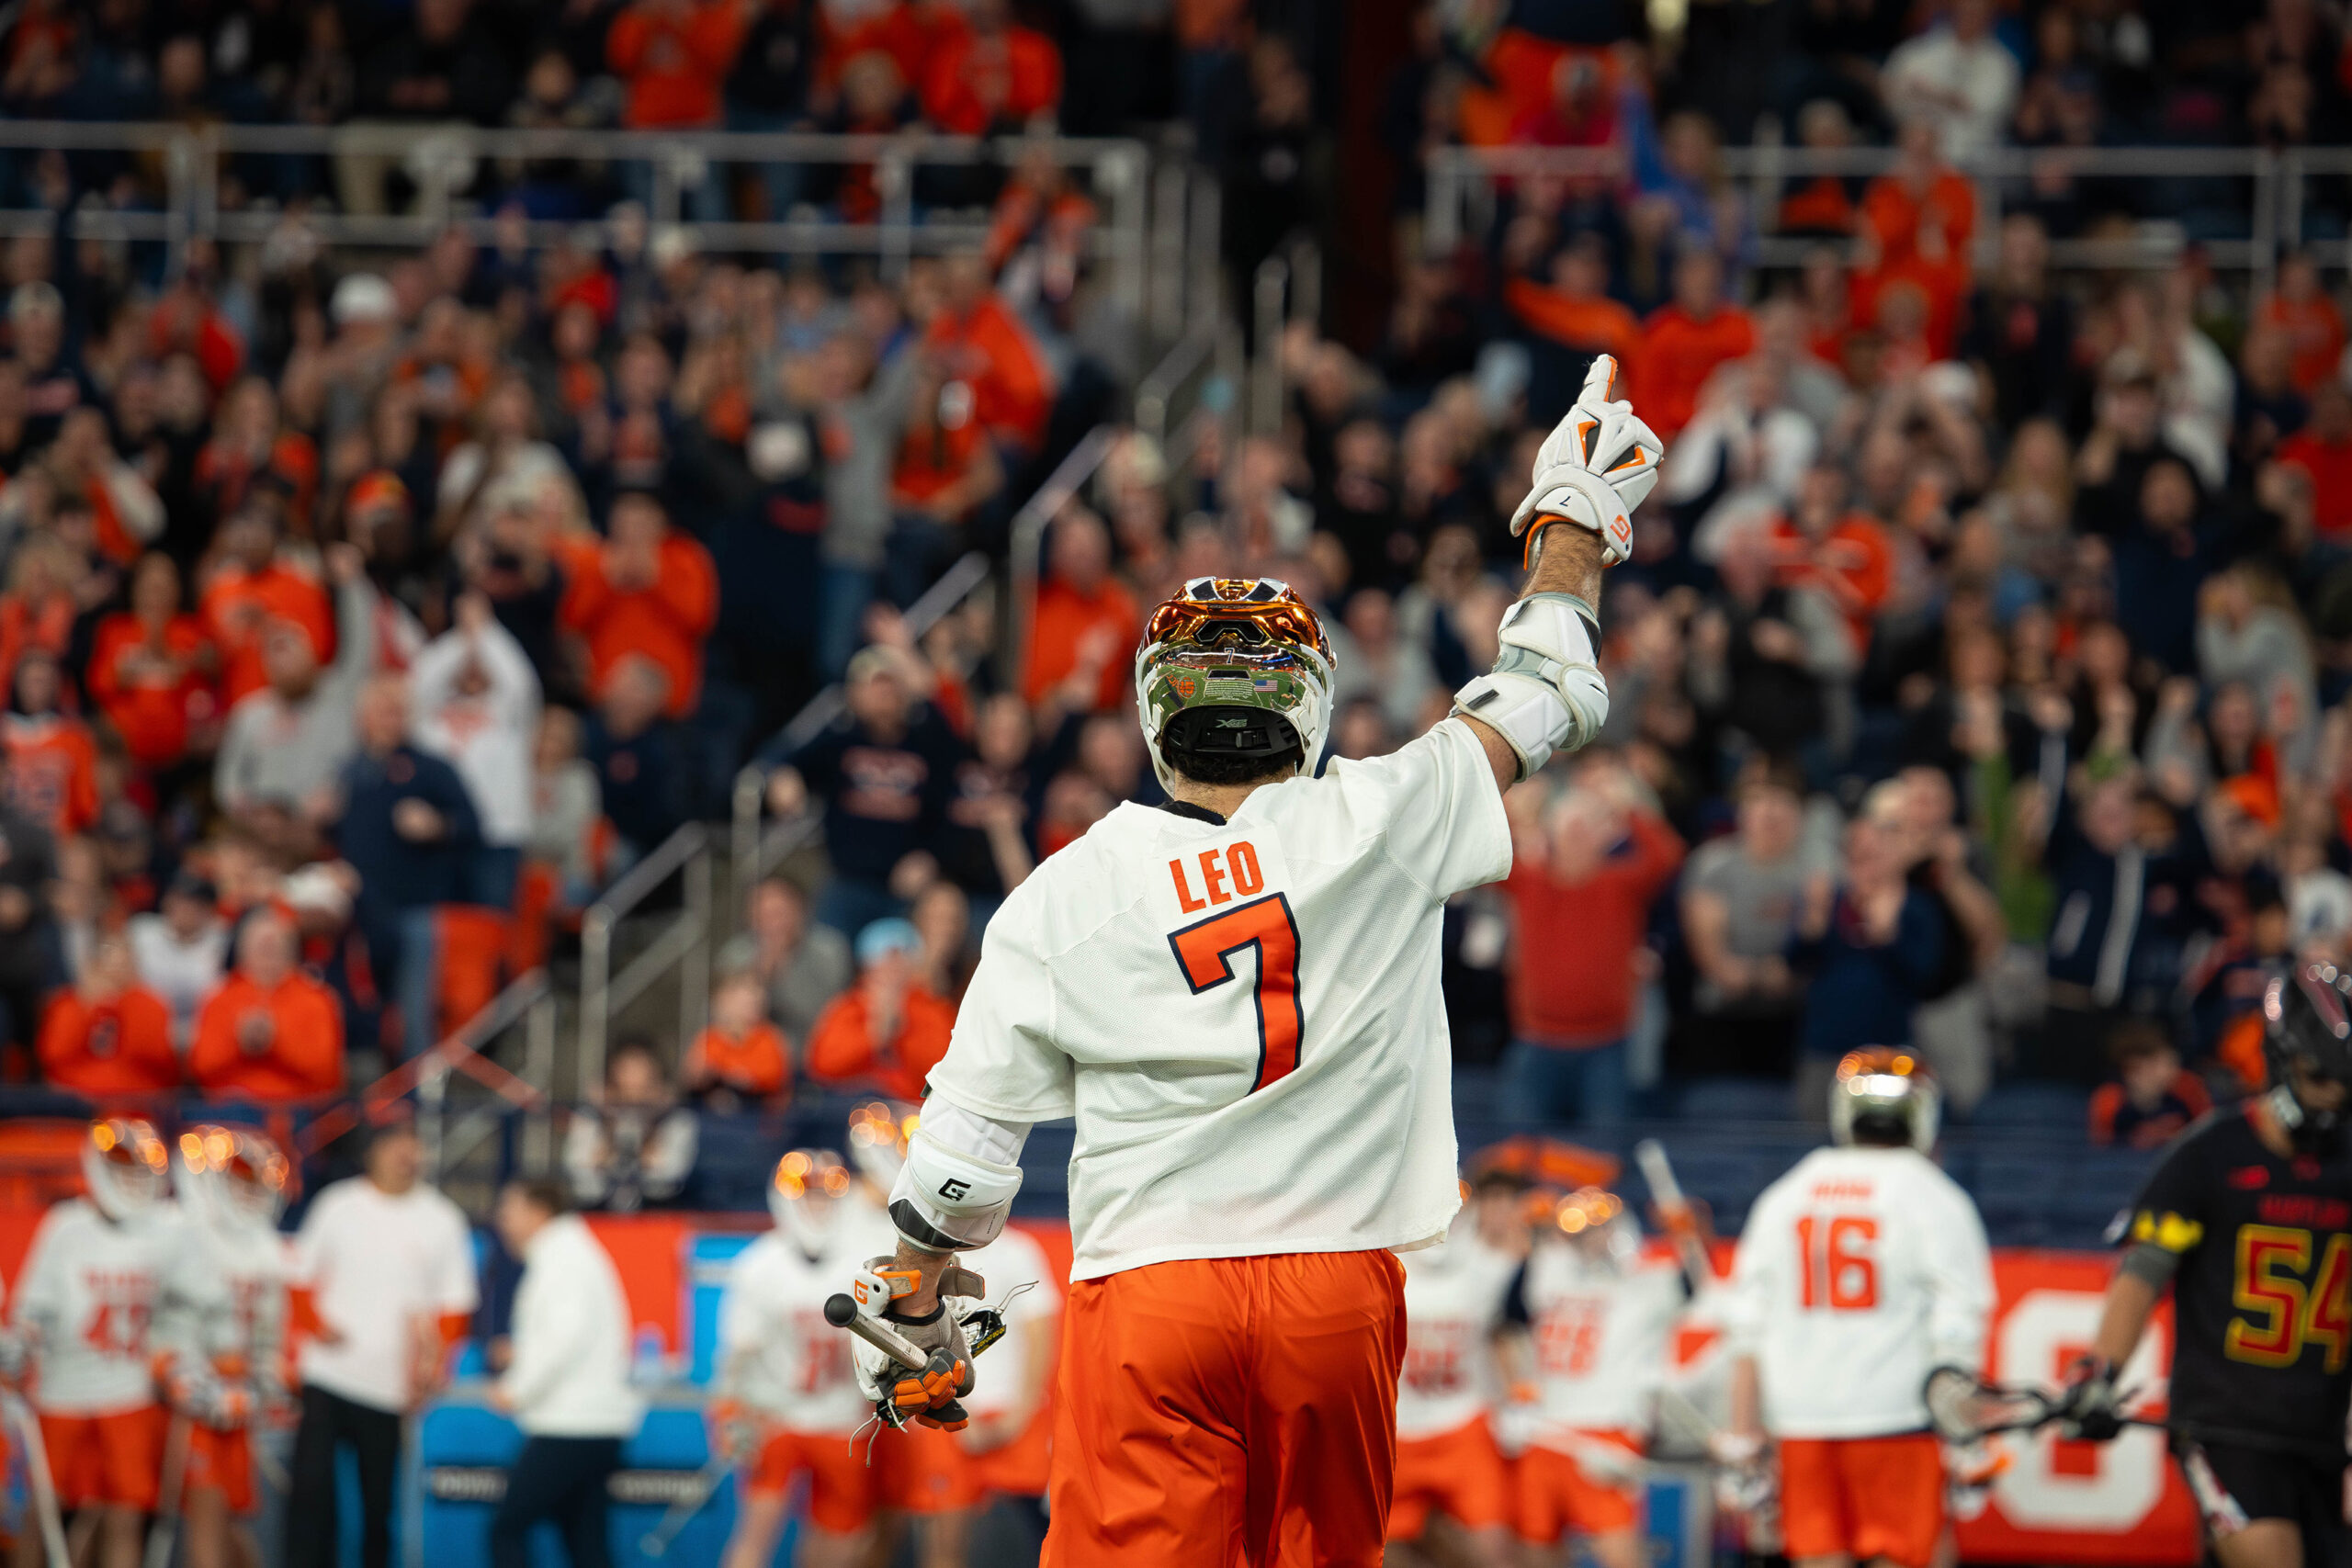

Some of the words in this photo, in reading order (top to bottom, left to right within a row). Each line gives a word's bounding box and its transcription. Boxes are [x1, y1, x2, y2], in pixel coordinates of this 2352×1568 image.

[1224, 647, 1236, 665] 7
[1169, 840, 1265, 914] LEO
[1167, 891, 1306, 1098] 7
[1796, 1214, 1878, 1311] 16
[2223, 1223, 2352, 1375] 54
